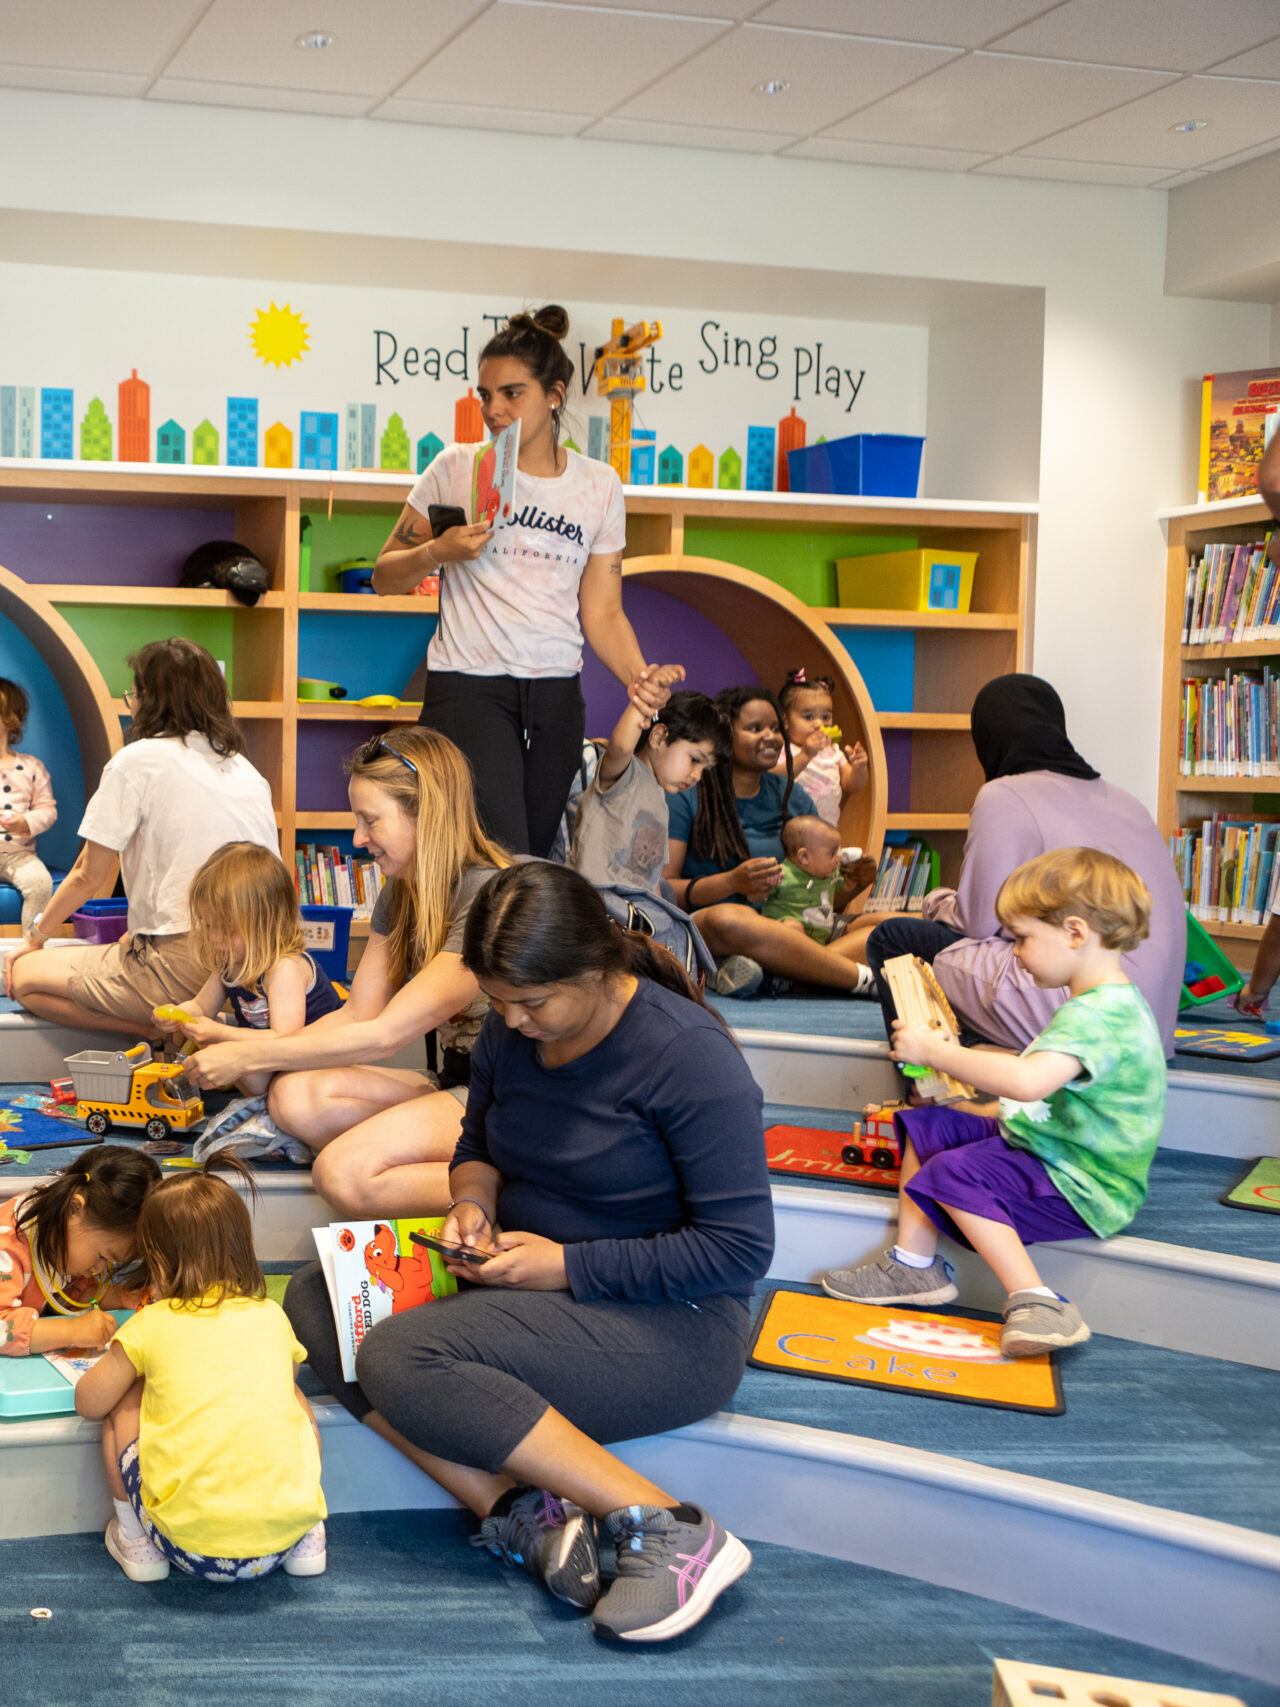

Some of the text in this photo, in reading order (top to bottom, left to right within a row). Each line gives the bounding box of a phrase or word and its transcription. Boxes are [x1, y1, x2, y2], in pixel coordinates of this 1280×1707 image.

[373, 320, 866, 413] Read Wte Sing Play
[500, 505, 584, 546] ollister
[767, 1149, 901, 1181] Umbre
[352, 1294, 365, 1350] ifford
[360, 1280, 372, 1332] ED DOG
[776, 1333, 958, 1384] Cake
